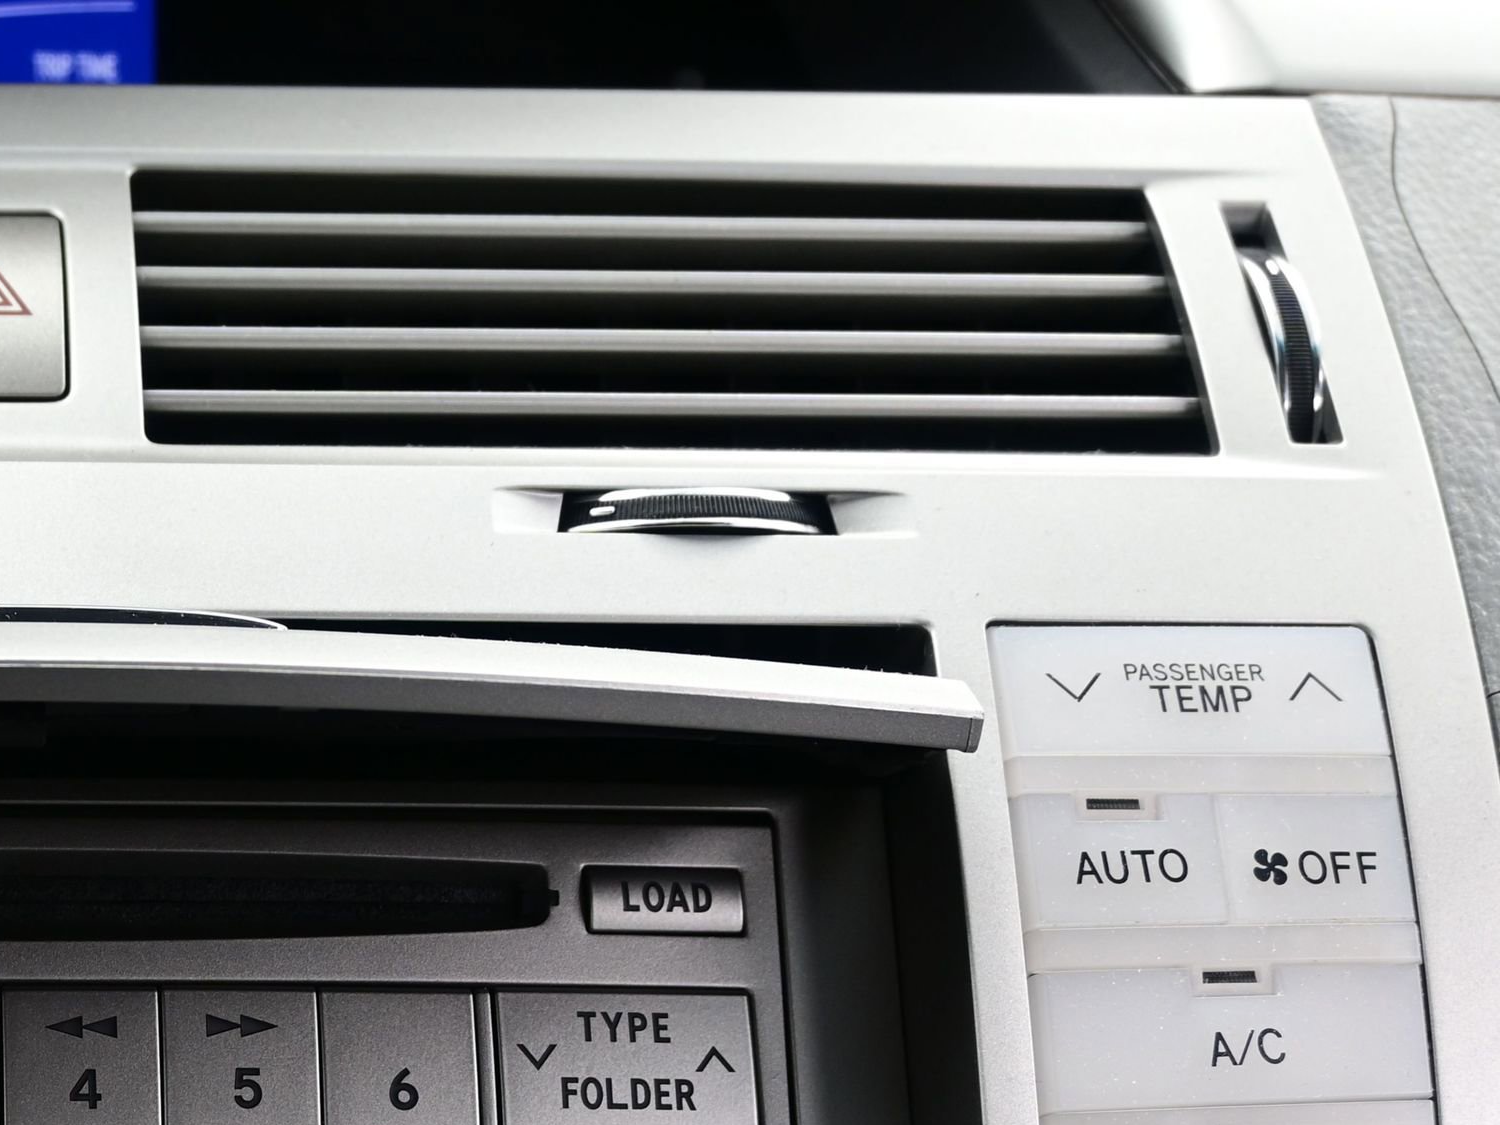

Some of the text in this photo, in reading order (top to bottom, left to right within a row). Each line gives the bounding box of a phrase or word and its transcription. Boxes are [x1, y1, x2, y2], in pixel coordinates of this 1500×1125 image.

[1123, 663, 1265, 682] PASSENGER
[1150, 685, 1251, 712] TEMP
[1077, 849, 1188, 884] AUTO
[1299, 852, 1378, 884] OFF
[621, 881, 712, 912] LOAD
[577, 1011, 671, 1043] TYPE
[1212, 1028, 1285, 1067] A/C
[70, 1069, 101, 1109] 4
[234, 1068, 262, 1109] 5
[389, 1068, 419, 1110] 6
[560, 1077, 696, 1111] FOLDER
